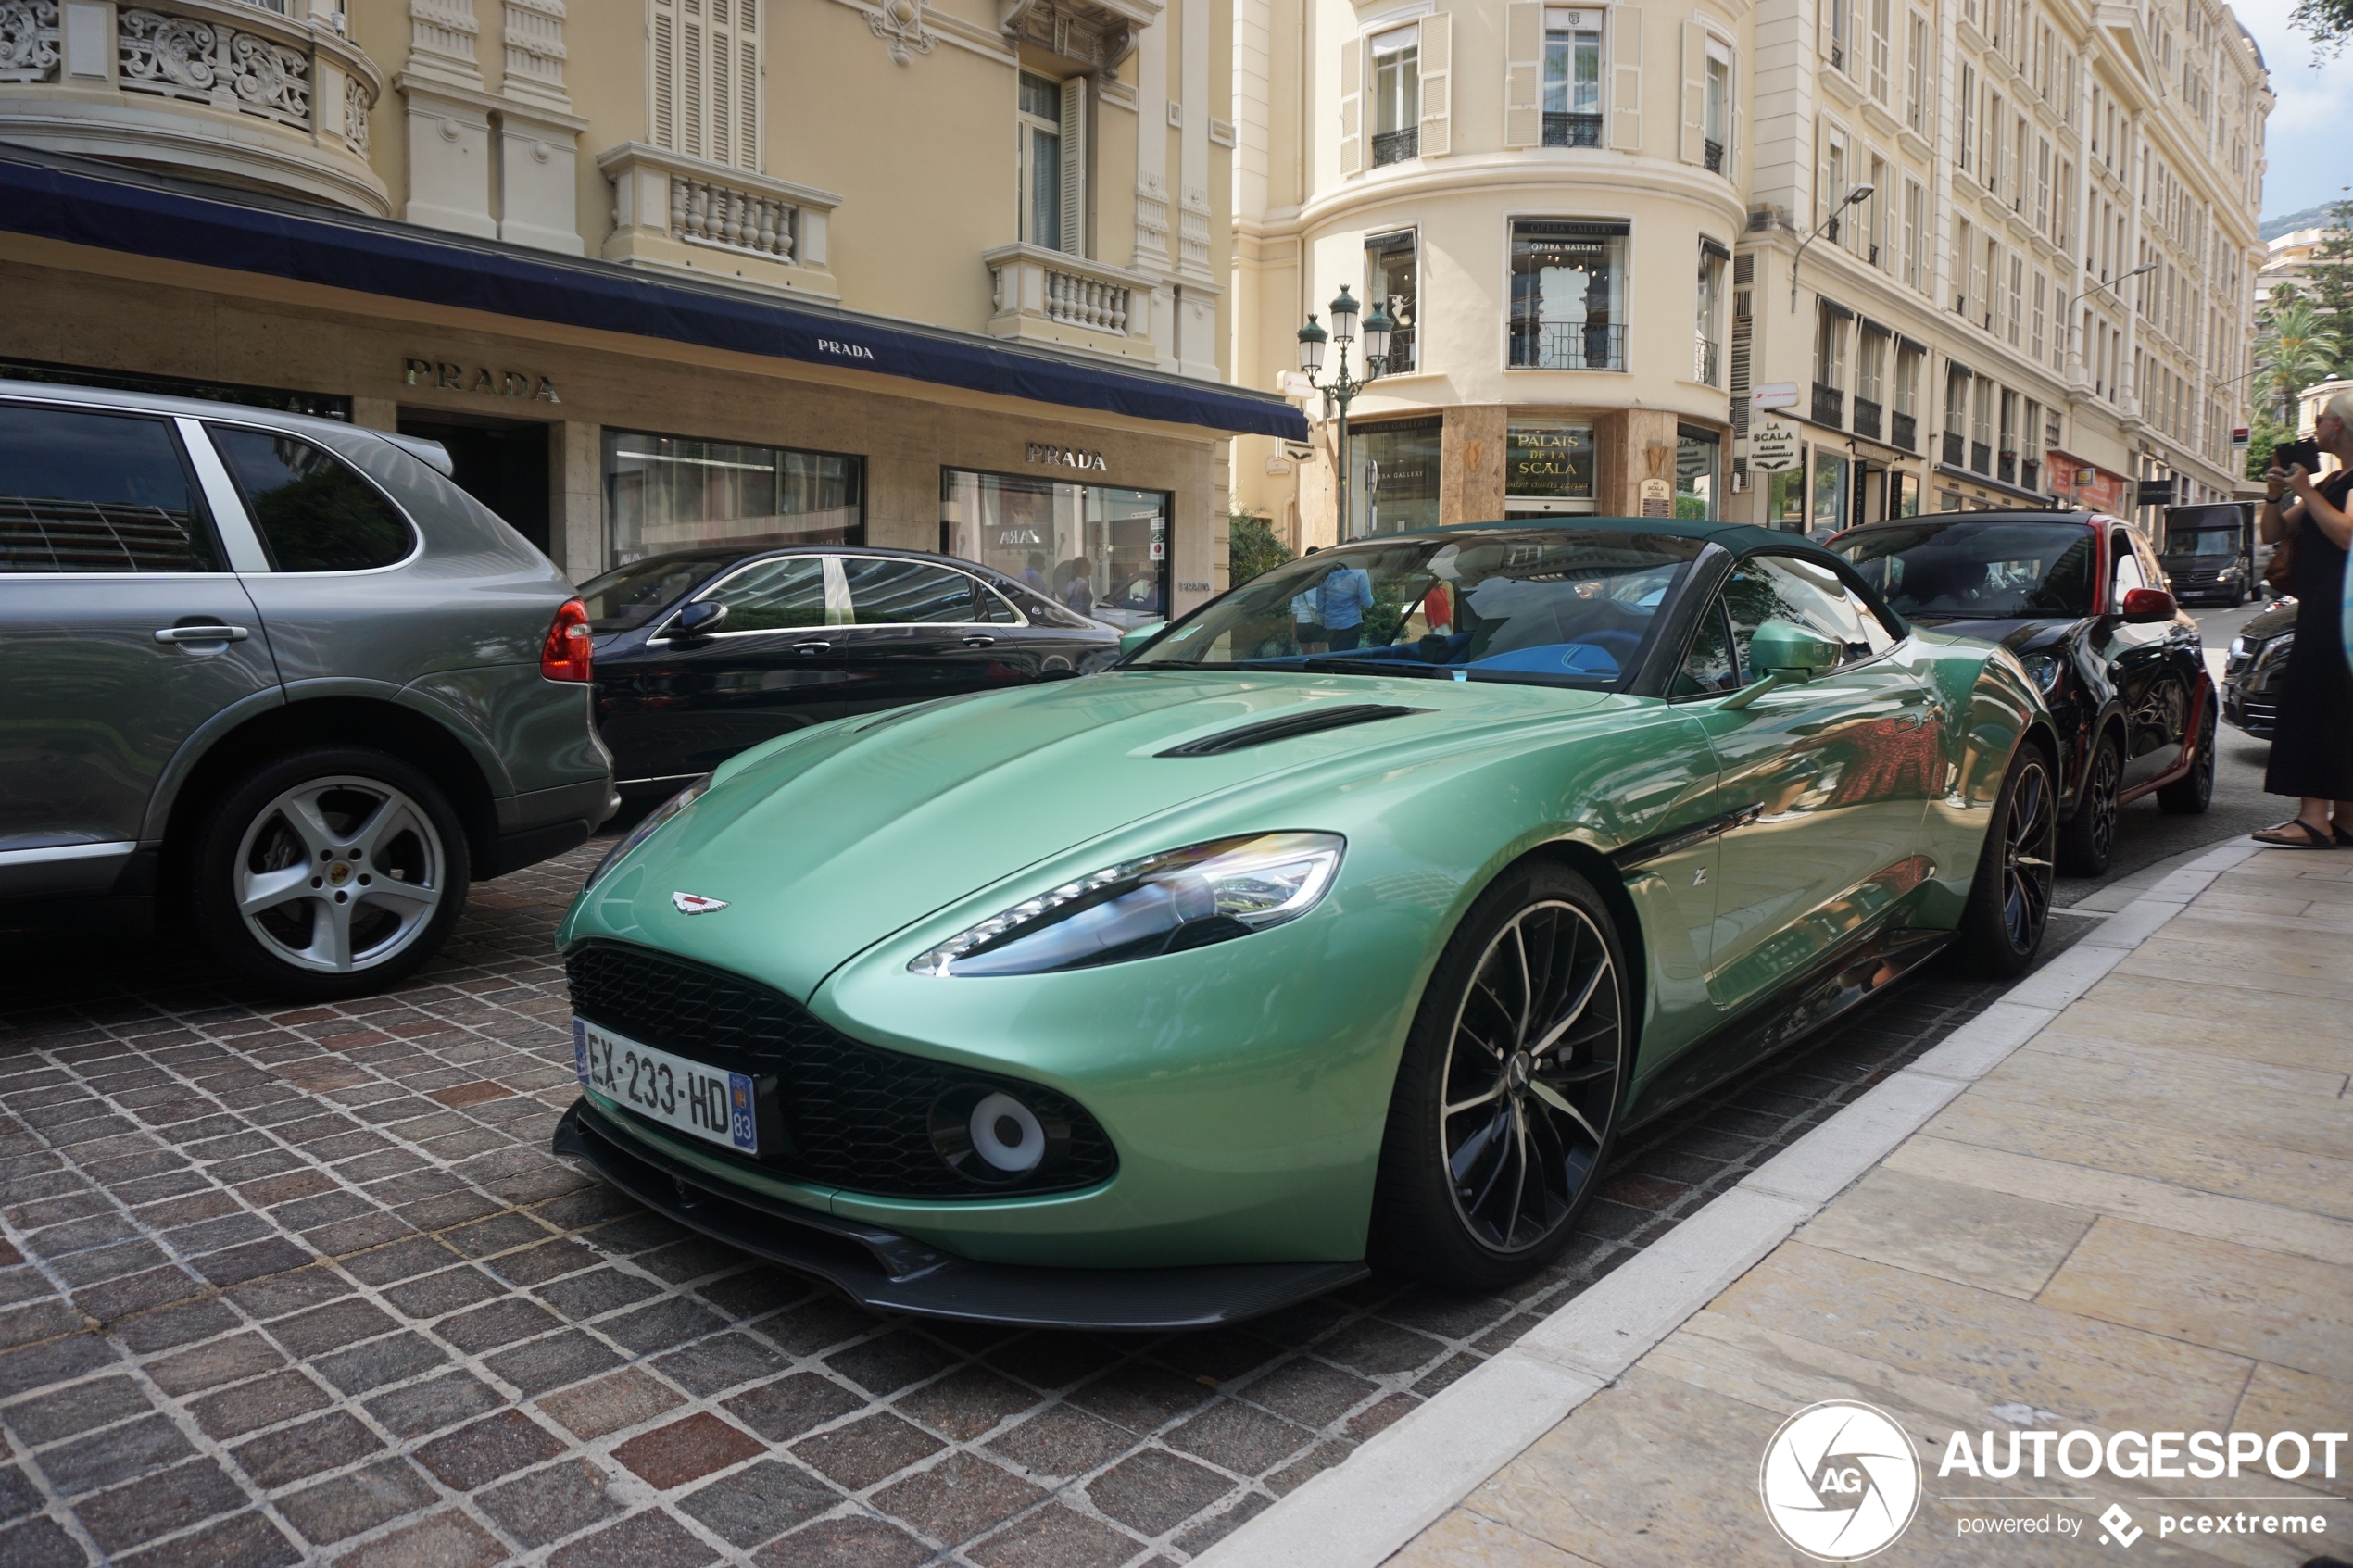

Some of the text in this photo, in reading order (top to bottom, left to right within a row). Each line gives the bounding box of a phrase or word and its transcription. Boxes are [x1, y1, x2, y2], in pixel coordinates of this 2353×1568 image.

[1530, 223, 1613, 233] OPERA GALLERY
[1531, 243, 1561, 251] OPERA
[818, 339, 875, 359] PRADA
[404, 358, 561, 403] PRADA
[1361, 419, 1428, 433] OPERA GALLERY
[1517, 434, 1579, 447] PALAIS
[1754, 432, 1793, 442] SCALA
[1026, 442, 1107, 470] PRADA
[1529, 450, 1566, 459] DE LA
[1519, 462, 1577, 475] SCALA
[1179, 582, 1211, 591] PRADA
[588, 1033, 729, 1135] EX-233-HD
[733, 1112, 751, 1140] 83
